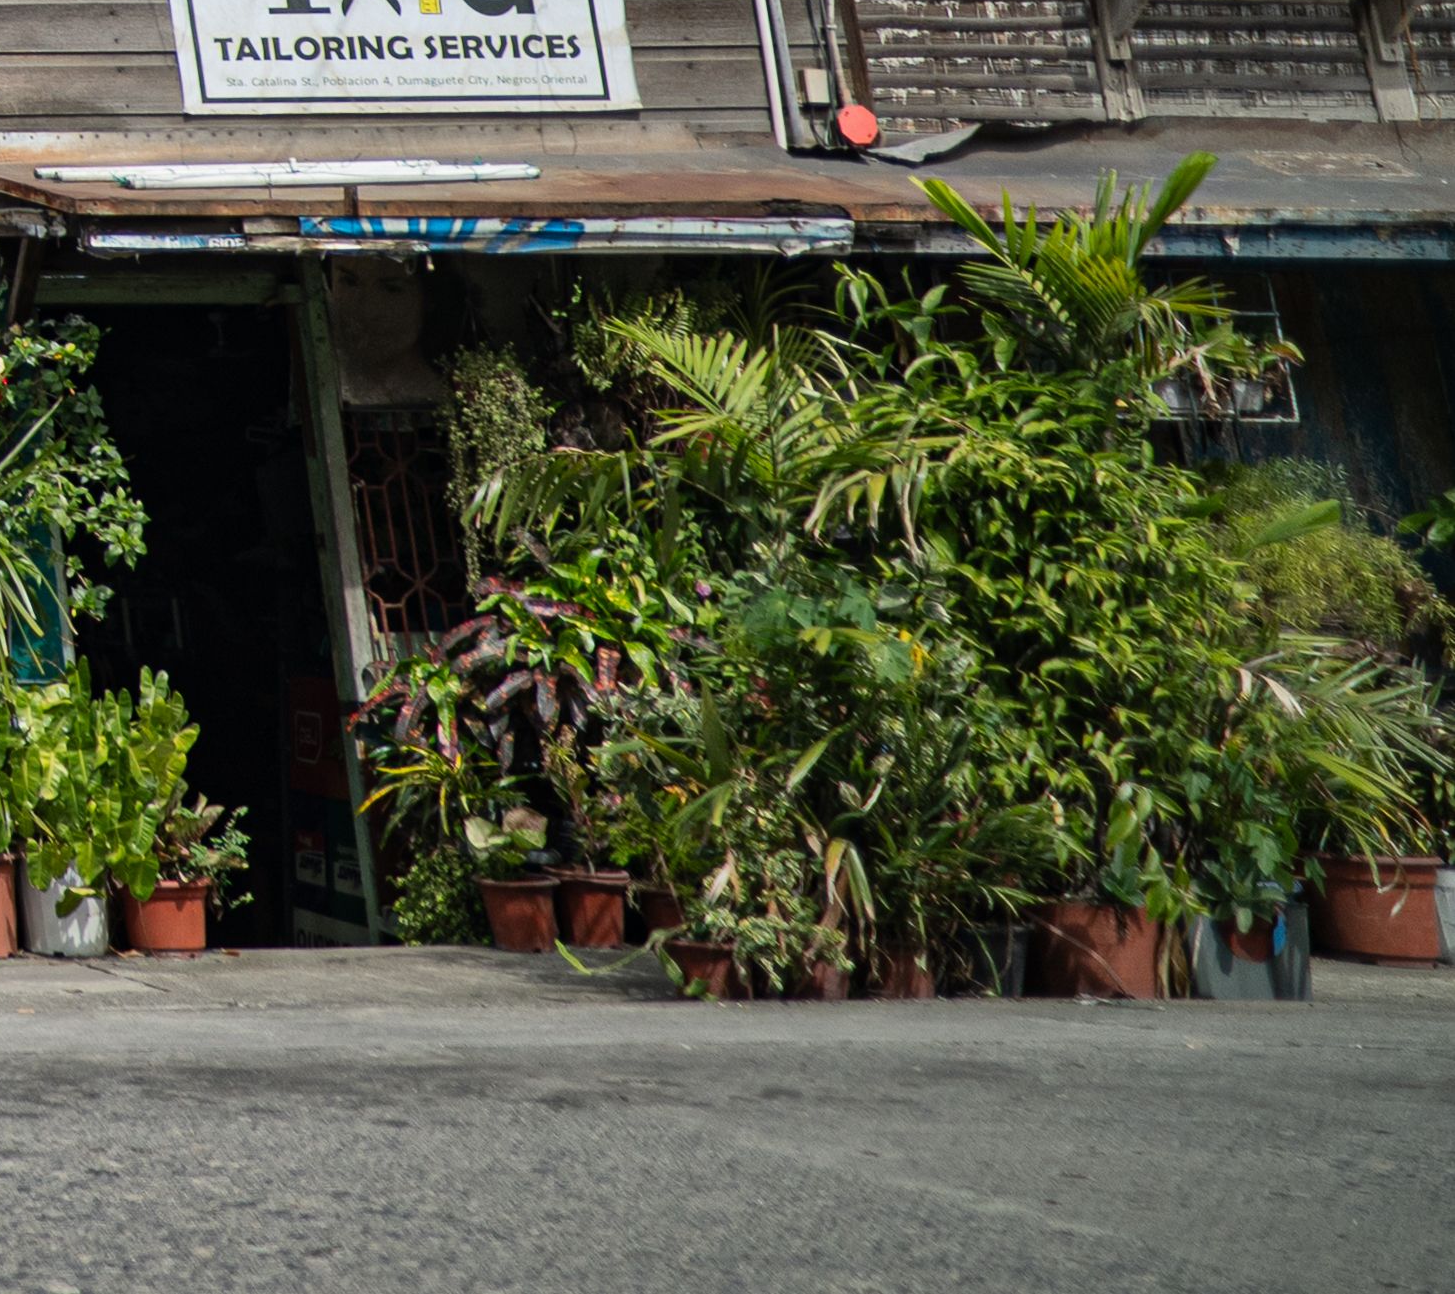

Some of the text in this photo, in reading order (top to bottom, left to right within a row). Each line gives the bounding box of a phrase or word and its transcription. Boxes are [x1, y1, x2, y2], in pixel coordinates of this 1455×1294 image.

[214, 34, 581, 61] TAILORING SERVICES
[226, 77, 246, 88] Sta.
[251, 76, 297, 88] Catalina
[323, 76, 379, 88] Poblacion
[397, 75, 464, 87] Dumaguete
[468, 75, 493, 88] City,
[496, 75, 538, 88] Negros
[542, 74, 587, 85] Oriental
